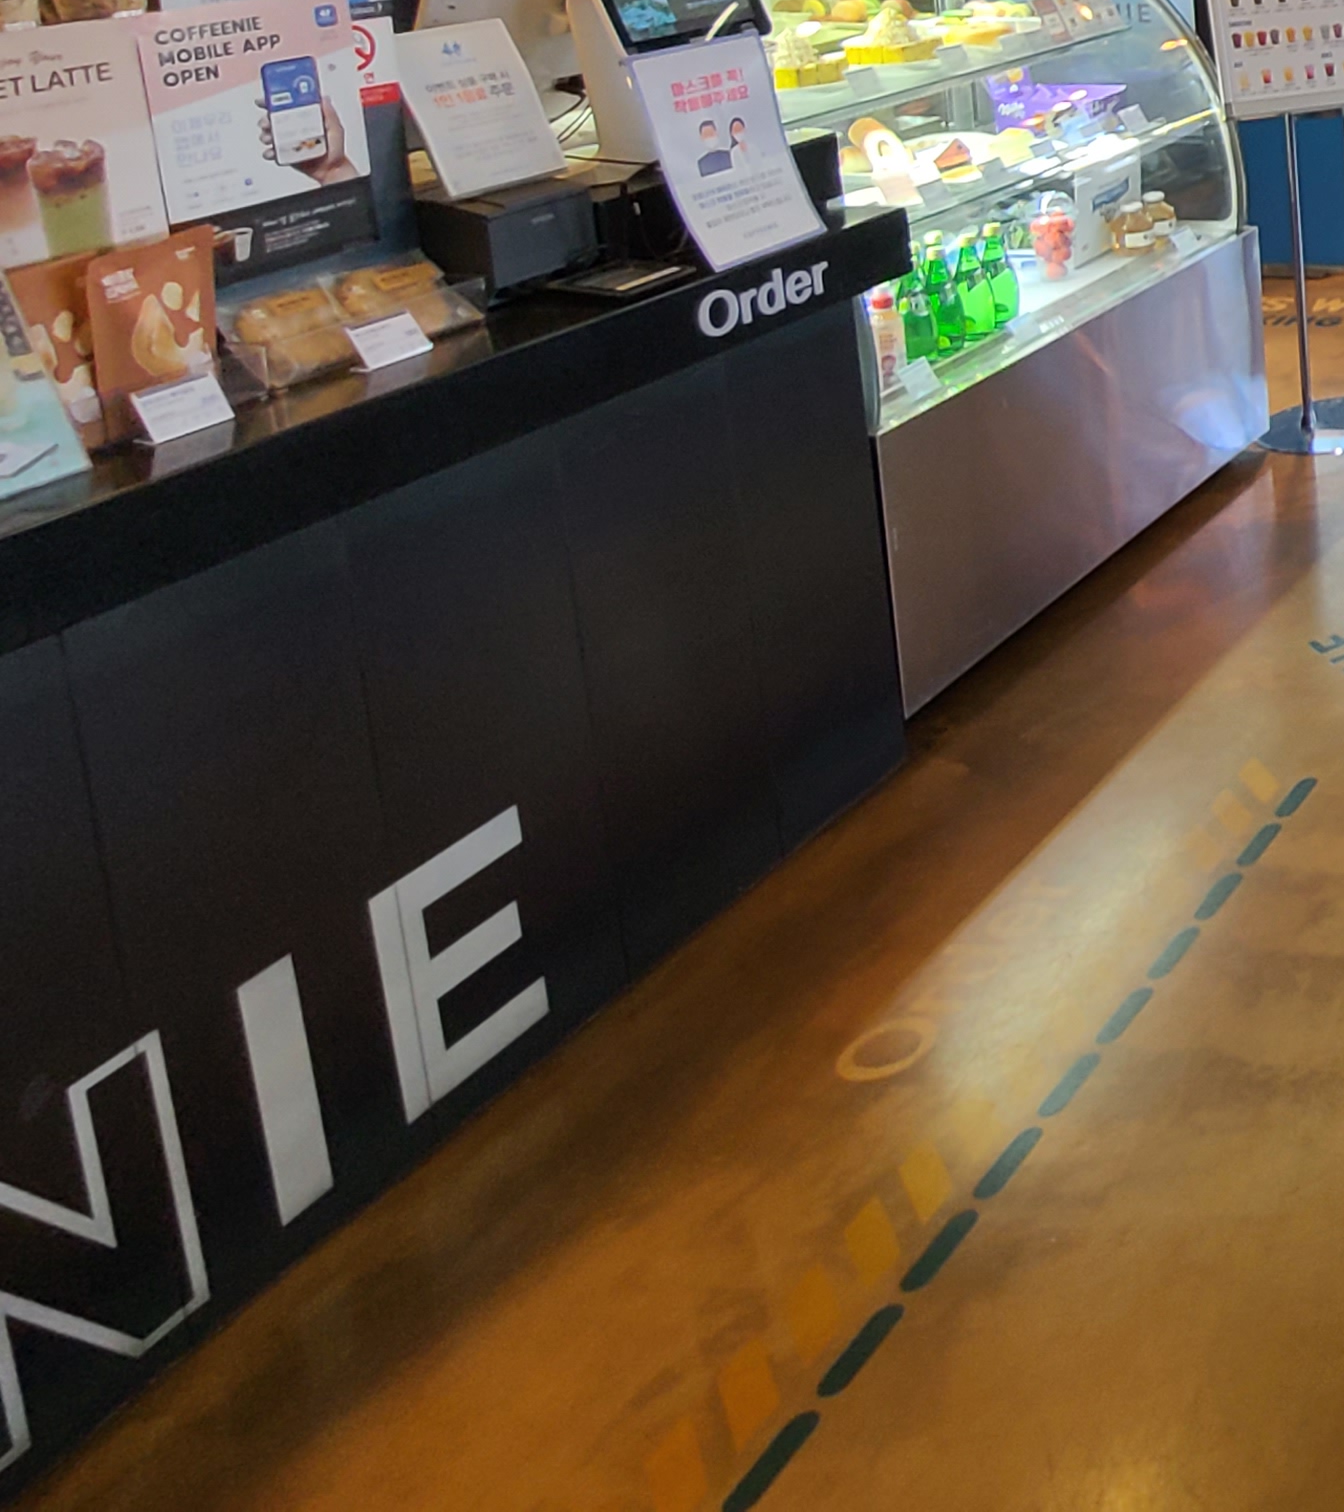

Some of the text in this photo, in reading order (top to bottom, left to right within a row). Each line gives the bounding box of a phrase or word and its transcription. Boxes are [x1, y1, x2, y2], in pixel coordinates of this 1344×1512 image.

[154, 16, 262, 46] COFFEENIE
[157, 34, 281, 67] MOBILE APP
[31, 62, 113, 93] LATTE
[162, 64, 220, 88] OPEN
[697, 260, 829, 338] Order
